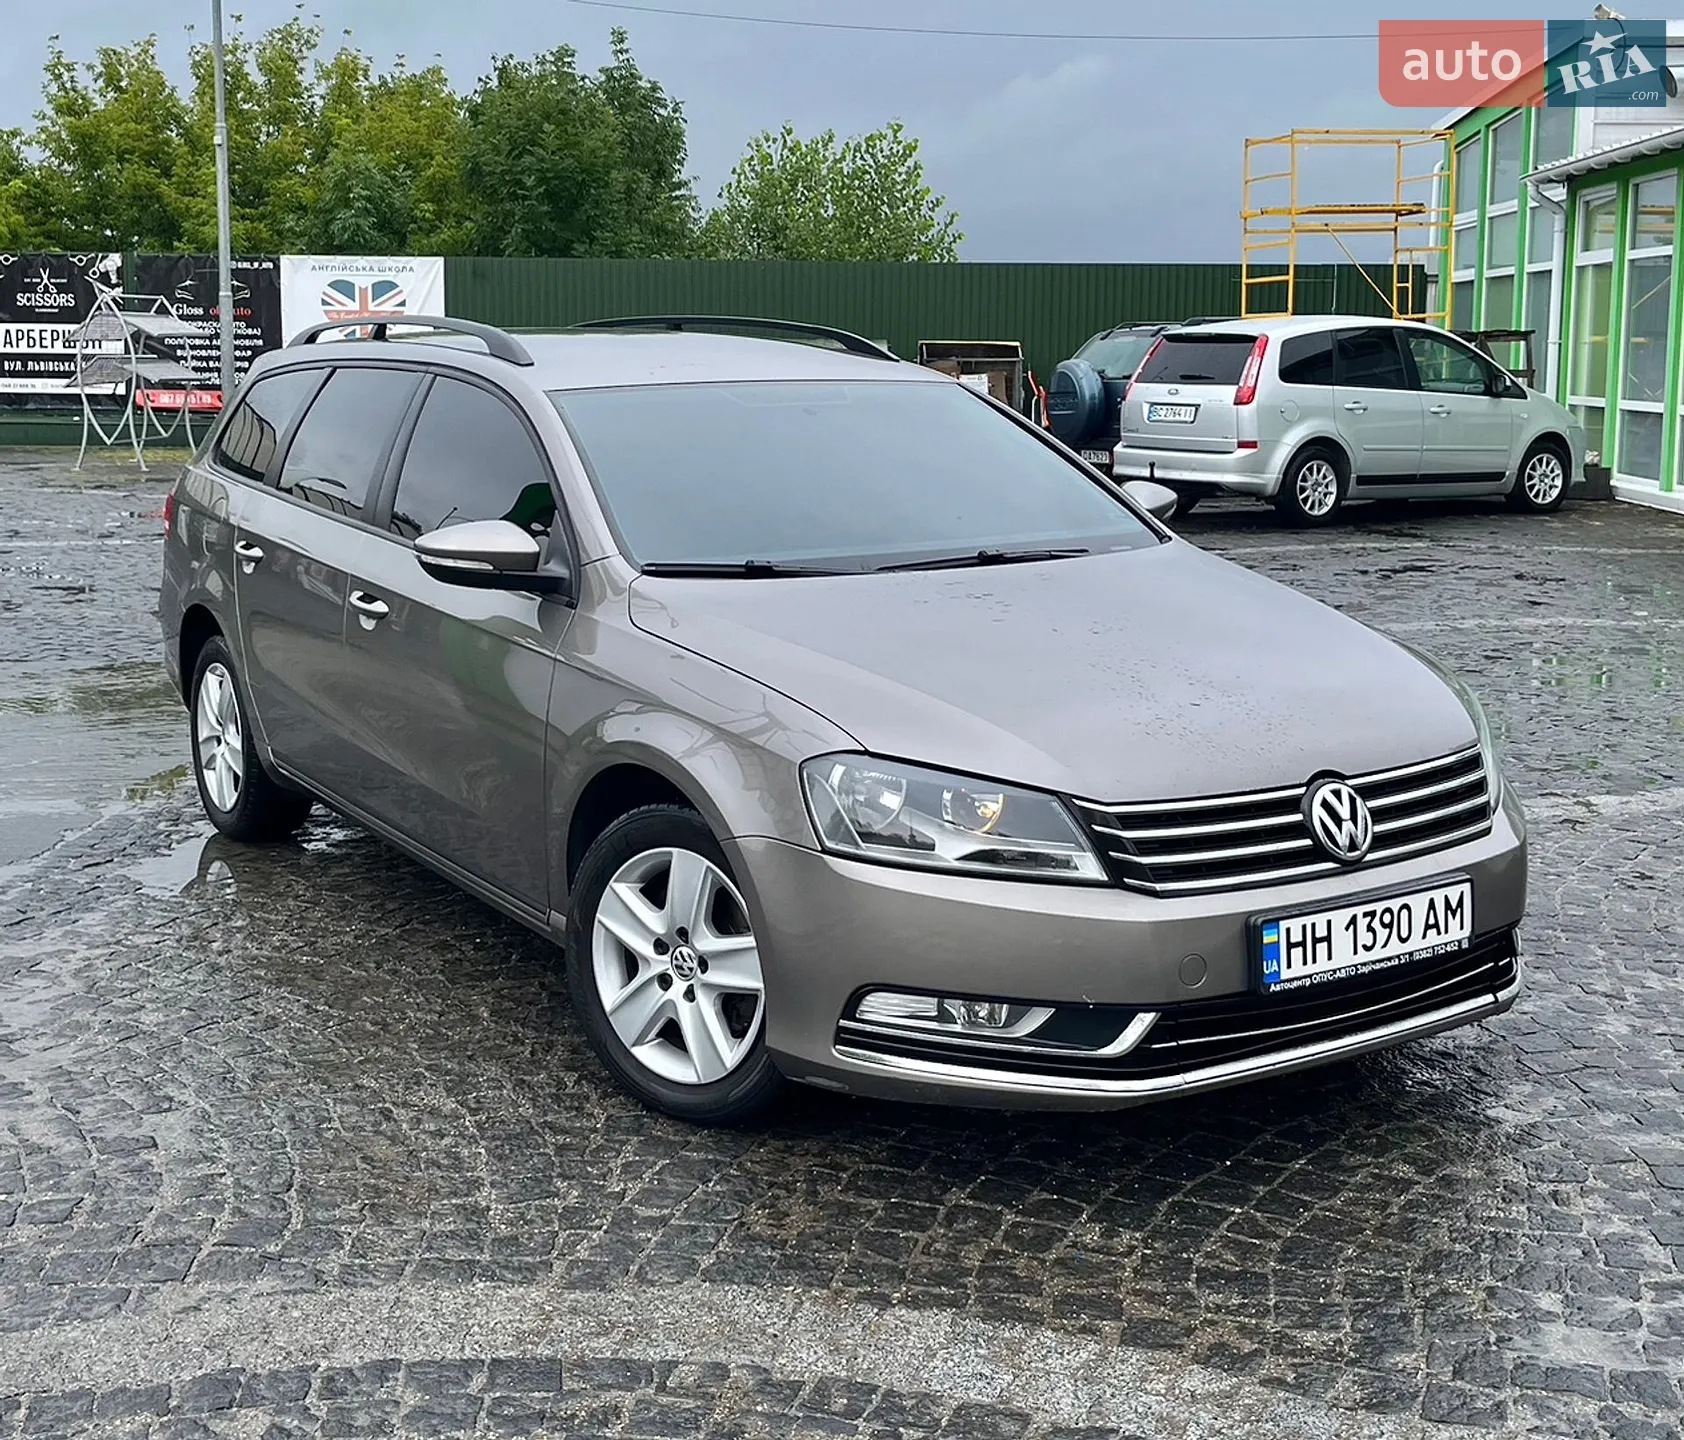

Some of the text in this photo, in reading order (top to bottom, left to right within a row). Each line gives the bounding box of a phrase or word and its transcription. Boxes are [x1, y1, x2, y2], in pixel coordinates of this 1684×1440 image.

[310, 263, 415, 273] АНГЛІЙСЬКА ШКОЛА
[16, 292, 76, 307] SCISSORS
[173, 303, 204, 316] Gloss
[4, 360, 76, 371] ВУЛ. ЛЬВІВСЬКА
[1285, 890, 1464, 970] HH 1390 AM
[1263, 959, 1279, 974] UA
[1269, 977, 1311, 992] Автоцентр
[1311, 966, 1356, 984] ОПУС-АВТО
